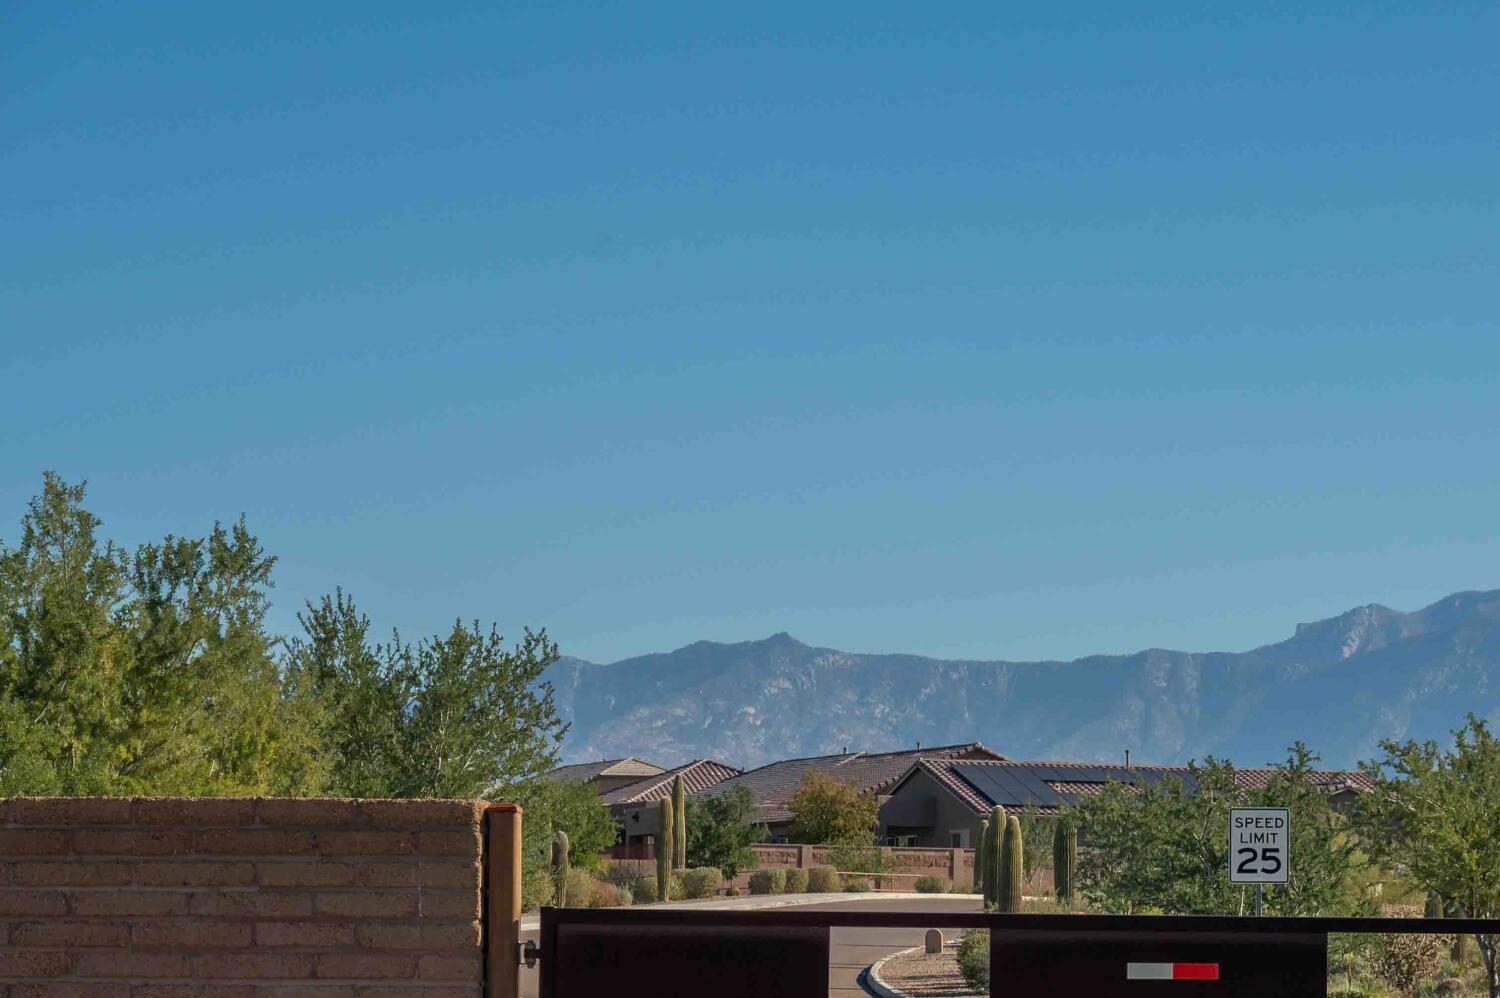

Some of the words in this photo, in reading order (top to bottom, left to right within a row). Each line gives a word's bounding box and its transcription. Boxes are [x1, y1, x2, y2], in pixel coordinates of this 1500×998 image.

[1235, 817, 1284, 828] SPEED
[1240, 832, 1278, 843] LIMIT
[1237, 848, 1281, 874] 25
